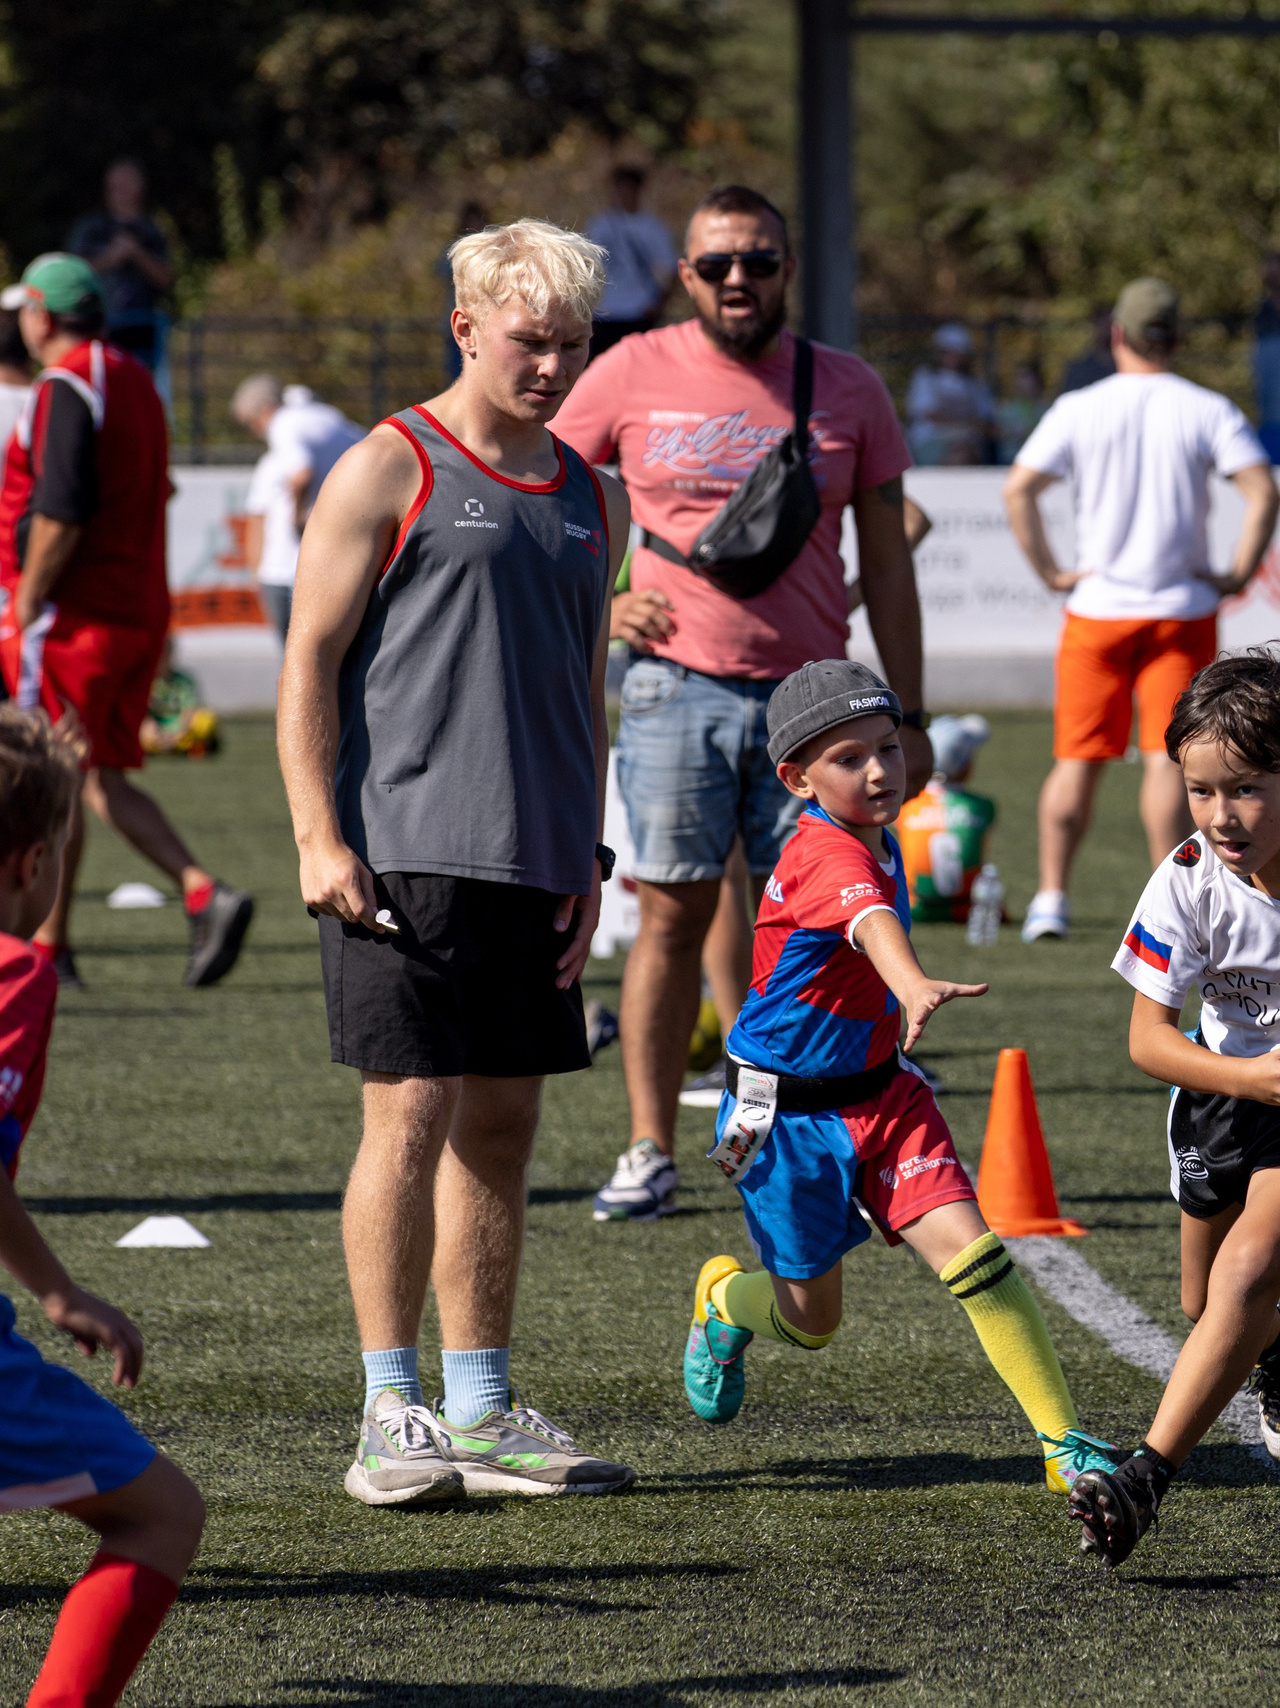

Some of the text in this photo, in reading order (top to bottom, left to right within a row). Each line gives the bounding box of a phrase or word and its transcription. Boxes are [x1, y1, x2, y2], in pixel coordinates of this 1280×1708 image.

[454, 519, 499, 530] centurion
[564, 521, 592, 537] RUSSIAN
[565, 528, 588, 541] RUGBY
[848, 696, 890, 711] FASHION
[898, 1154, 928, 1172] РЕГБИ
